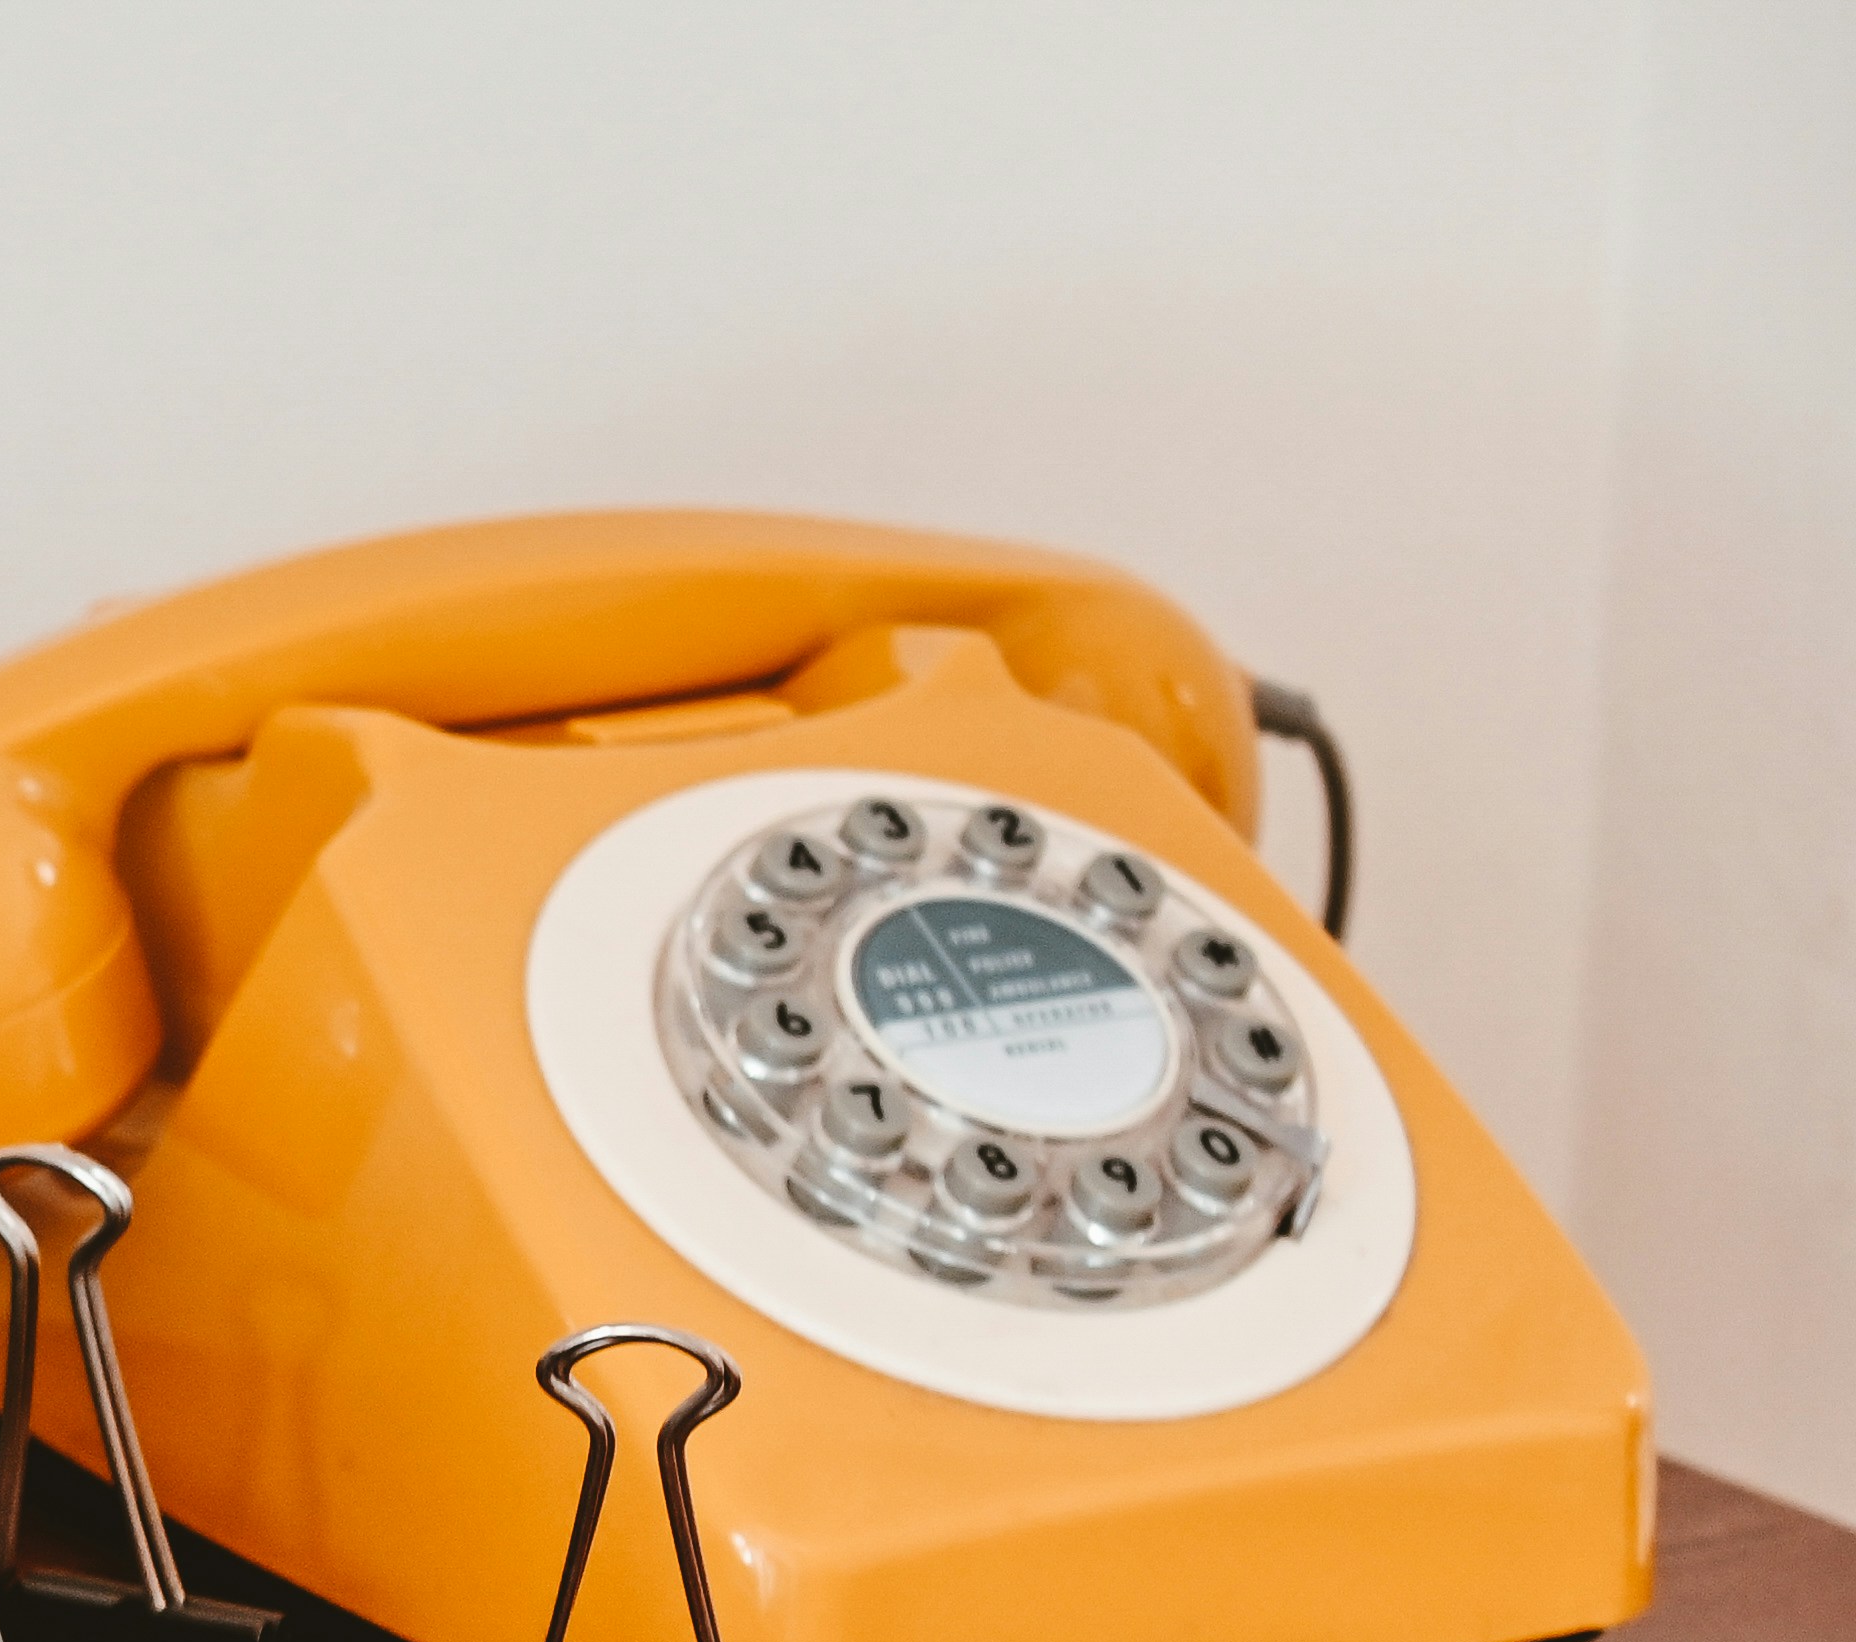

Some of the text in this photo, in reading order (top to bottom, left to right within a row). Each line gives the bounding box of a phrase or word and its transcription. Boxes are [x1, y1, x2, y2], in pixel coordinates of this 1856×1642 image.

[869, 802, 910, 841] 3
[986, 808, 1034, 848] 2
[788, 840, 822, 875] 4
[745, 911, 787, 950] 5
[775, 1001, 812, 1037] 6
[850, 1084, 885, 1121] 7
[976, 1143, 1019, 1181] 8
[1199, 1127, 1241, 1166] 0
[1101, 1157, 1138, 1194] 9
